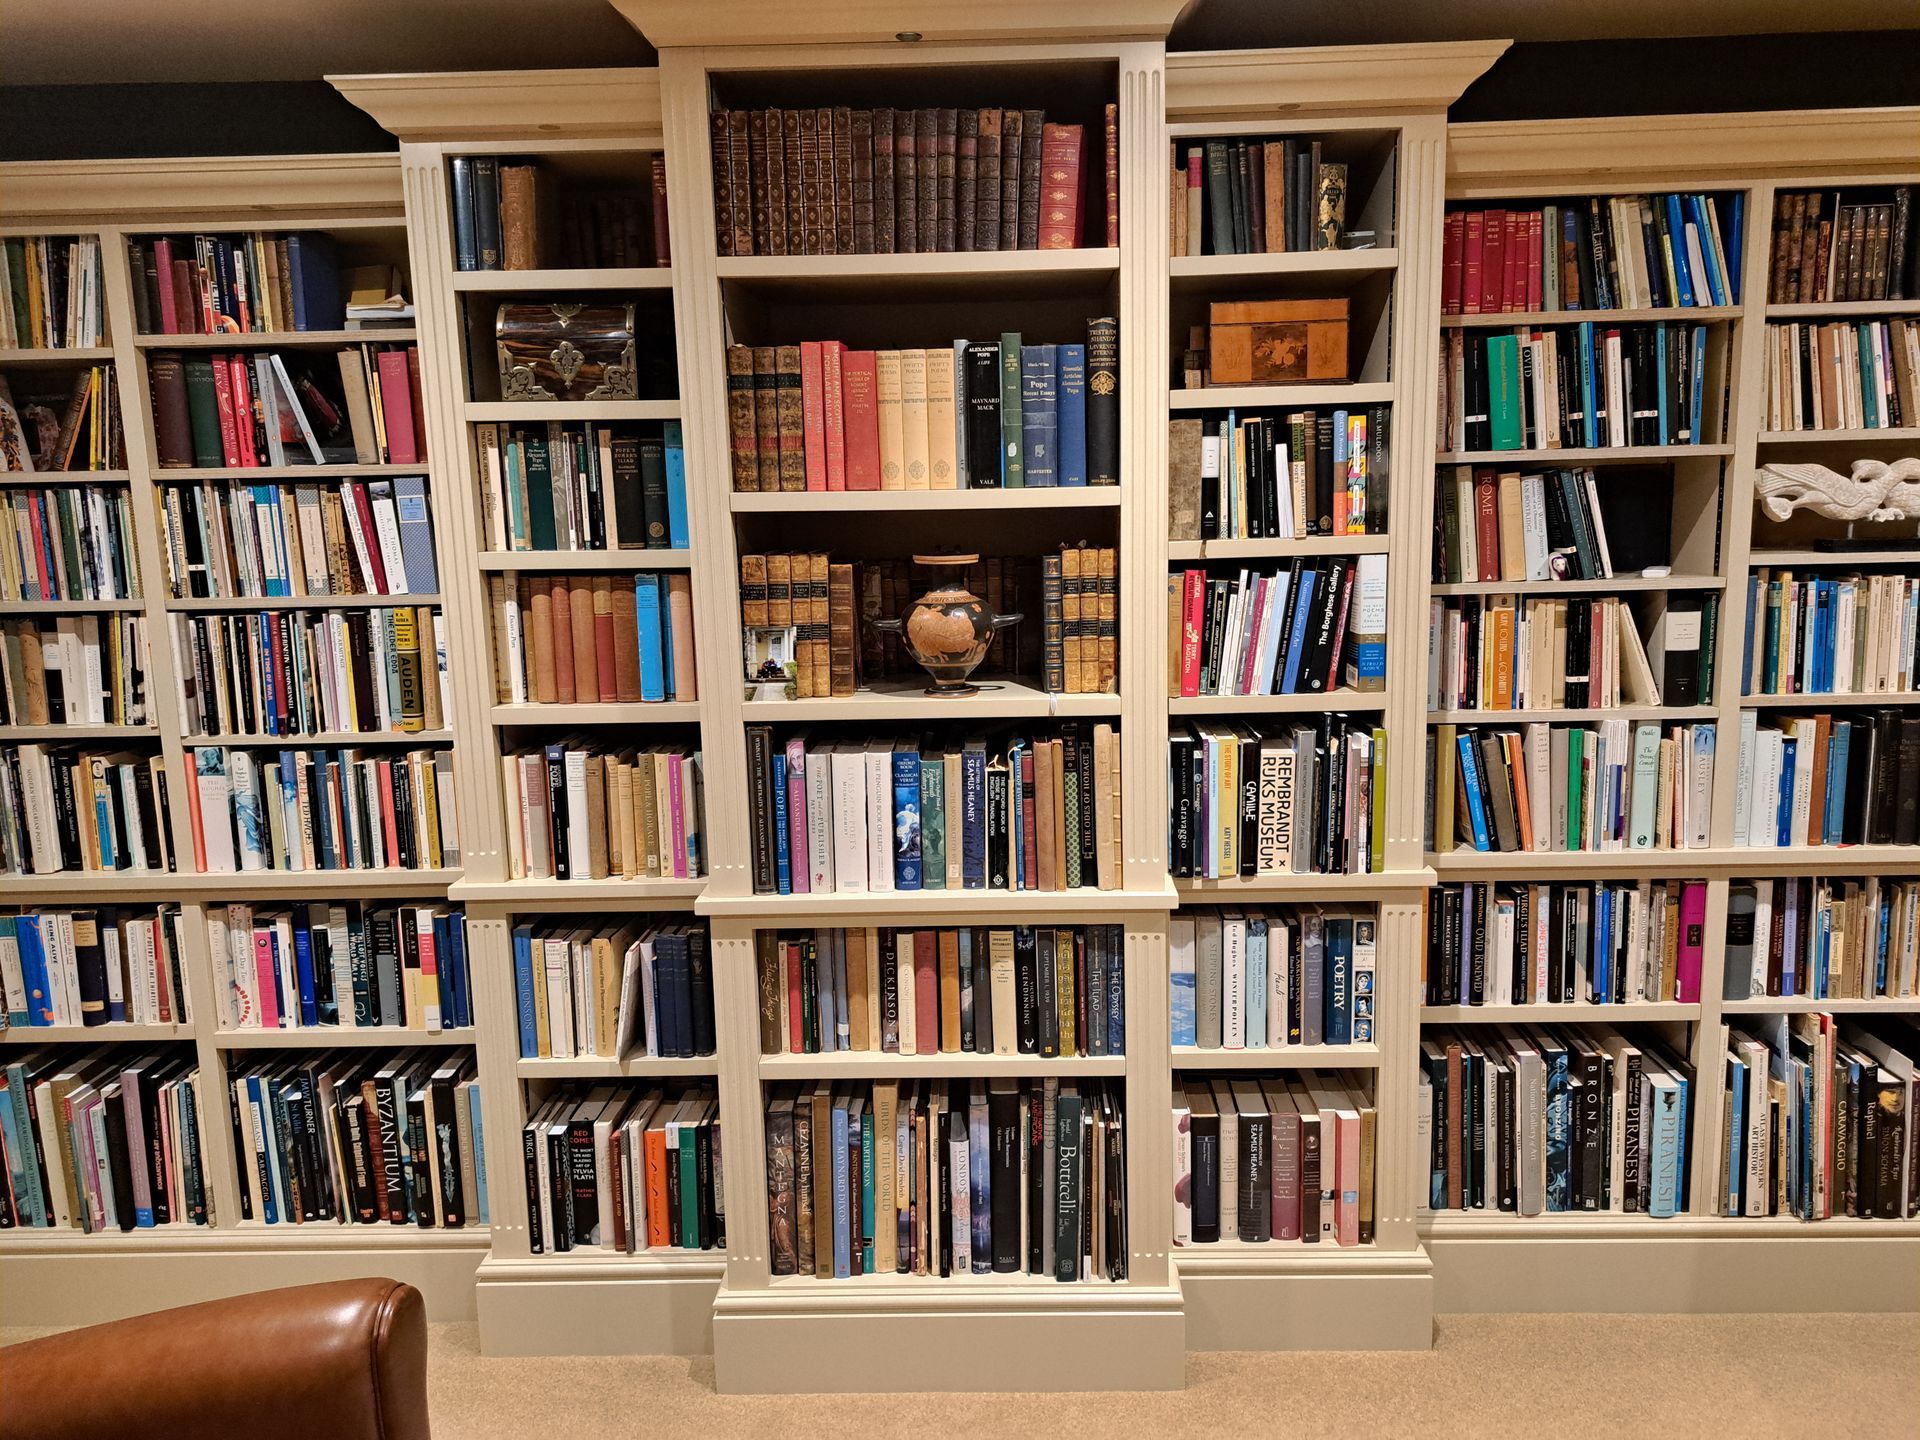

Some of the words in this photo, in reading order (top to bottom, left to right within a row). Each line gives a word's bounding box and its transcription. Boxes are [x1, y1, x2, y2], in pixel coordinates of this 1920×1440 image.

[213, 365, 223, 389] FRY
[1523, 350, 1532, 378] OVID
[1030, 380, 1048, 388] Pope
[1375, 407, 1383, 424] PAUL
[1293, 451, 1299, 460] TO
[1481, 477, 1492, 516] ROME
[1193, 575, 1201, 599] CRITICAL
[1328, 565, 1340, 593] Gallery
[1186, 575, 1195, 622] REVOLUTIONARIES
[1300, 580, 1310, 607] National
[387, 614, 395, 629] THE
[1295, 608, 1305, 629] Gallery
[1322, 594, 1335, 629] Borghese
[264, 648, 271, 656] IN
[388, 630, 397, 653] ELDER
[1292, 636, 1300, 647] Art
[1319, 631, 1329, 645] The
[266, 674, 273, 682] OF
[266, 683, 274, 701] WAR
[401, 657, 414, 709] AUDEN
[62, 766, 70, 787] ANTONIO
[967, 759, 975, 789] SEAMUS
[1697, 750, 1706, 795] CAUSLEY
[64, 788, 72, 810] MACHADO
[644, 779, 653, 801] POPE
[967, 792, 975, 822] HEANEY
[1276, 757, 1292, 853] REMBRANDT
[646, 810, 654, 846] HORACE
[1178, 799, 1189, 848] Caravaggio
[1260, 802, 1274, 870] MUSEUM
[1520, 894, 1528, 928] VIRGIL'S
[364, 918, 372, 949] ANTHONY
[1475, 928, 1485, 951] OVID
[1520, 930, 1528, 953] ILIAD
[366, 950, 374, 977] BURGESS
[520, 967, 528, 986] BEN
[1092, 968, 1101, 987] THE
[1112, 971, 1121, 984] THE
[1209, 943, 1217, 985] STEPPING
[1474, 954, 1484, 993] RENEWED
[886, 952, 896, 1028] DICKINSON
[1022, 966, 1030, 1024] GLENDINNING
[1334, 956, 1345, 1010] POETRY
[522, 988, 532, 1030] JONSON
[1092, 988, 1102, 1011] ILIAD
[1112, 986, 1121, 1020] ODYSSEY
[291, 1104, 299, 1112] St
[881, 1102, 889, 1131] BIRDS
[1586, 1064, 1598, 1148] BRONZE
[250, 1103, 264, 1151] REMBRANDT
[292, 1114, 302, 1135] Kilda
[1864, 1102, 1875, 1140] Raphael
[376, 1088, 402, 1193] BYZANTIUM
[882, 1135, 890, 1148] OF
[1626, 1108, 1638, 1184] PIRANESI
[1759, 1141, 1765, 1150] OF
[1837, 1100, 1846, 1171] CARAVAGGIO
[1881, 1126, 1889, 1152] SIMON
[882, 1152, 890, 1171] THE
[959, 1150, 967, 1194] LONDON
[1250, 1154, 1258, 1182] HEANEY
[1658, 1116, 1676, 1205] PIRANESI
[1750, 1142, 1758, 1177] HISTORY
[1880, 1154, 1889, 1186] SCHAMA
[257, 1153, 270, 1201] CARAVAGGIO
[1059, 1146, 1076, 1214] Botticelli
